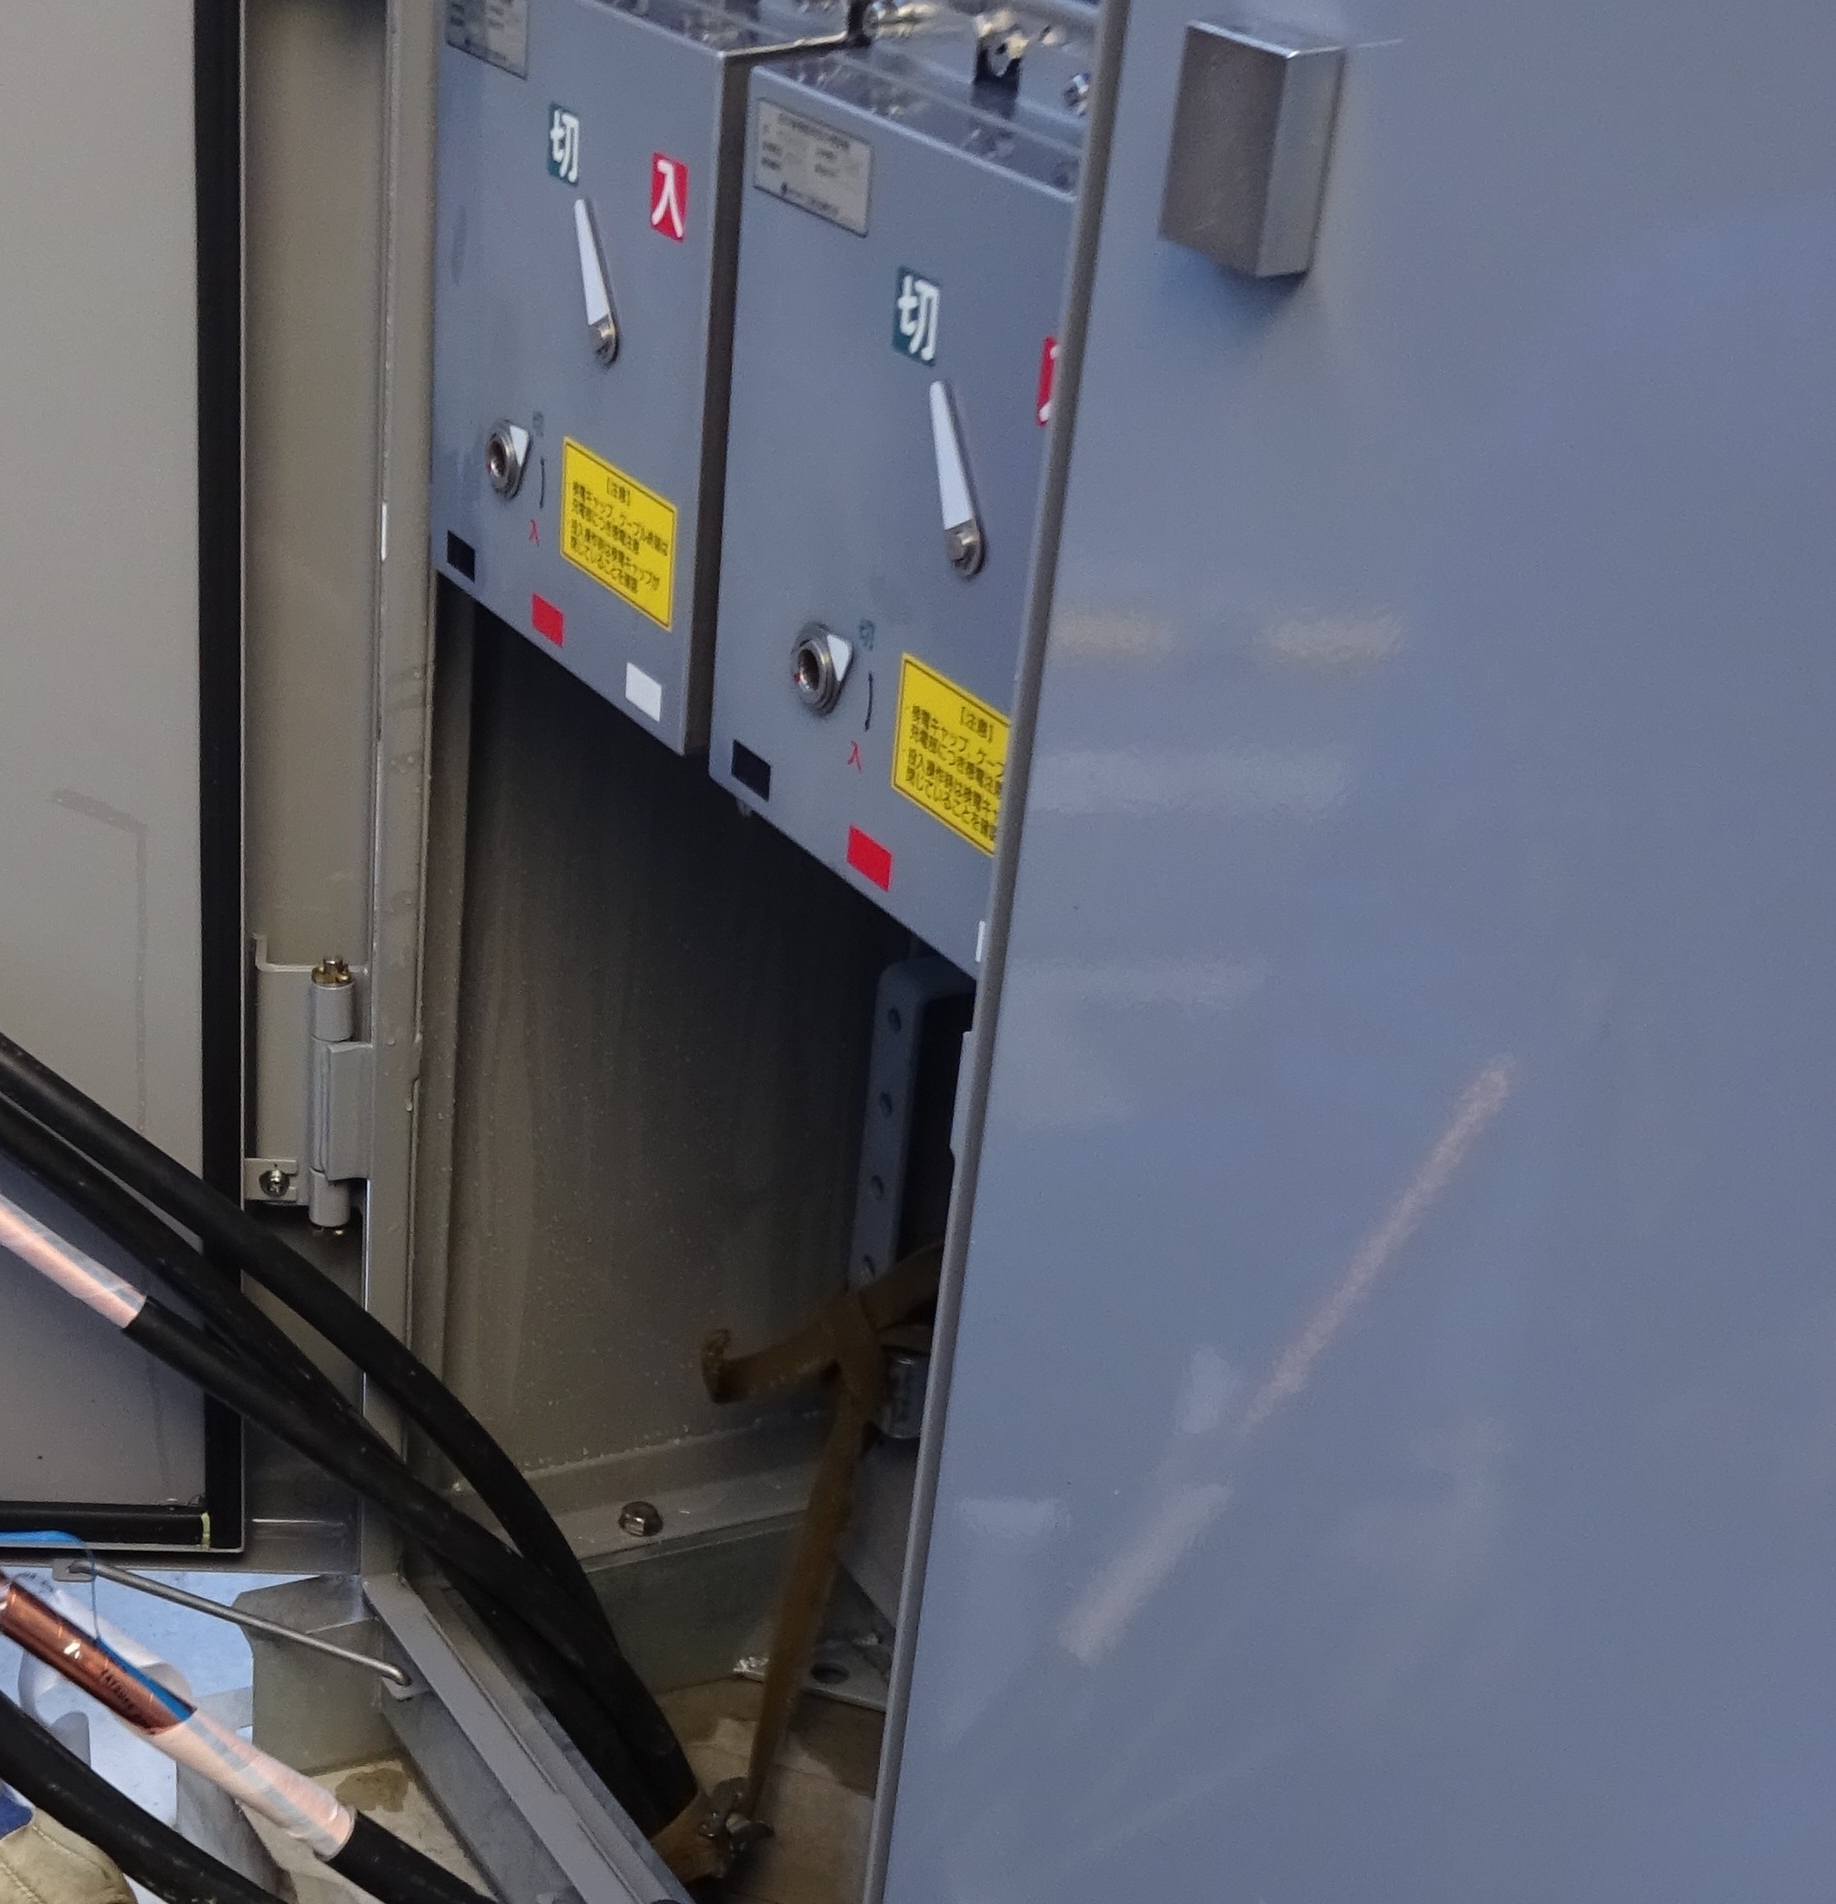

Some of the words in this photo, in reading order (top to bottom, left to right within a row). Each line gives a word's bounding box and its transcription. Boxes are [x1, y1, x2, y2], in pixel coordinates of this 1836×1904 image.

[550, 109, 579, 183] 切
[651, 159, 684, 238] 入
[897, 275, 940, 361] 切
